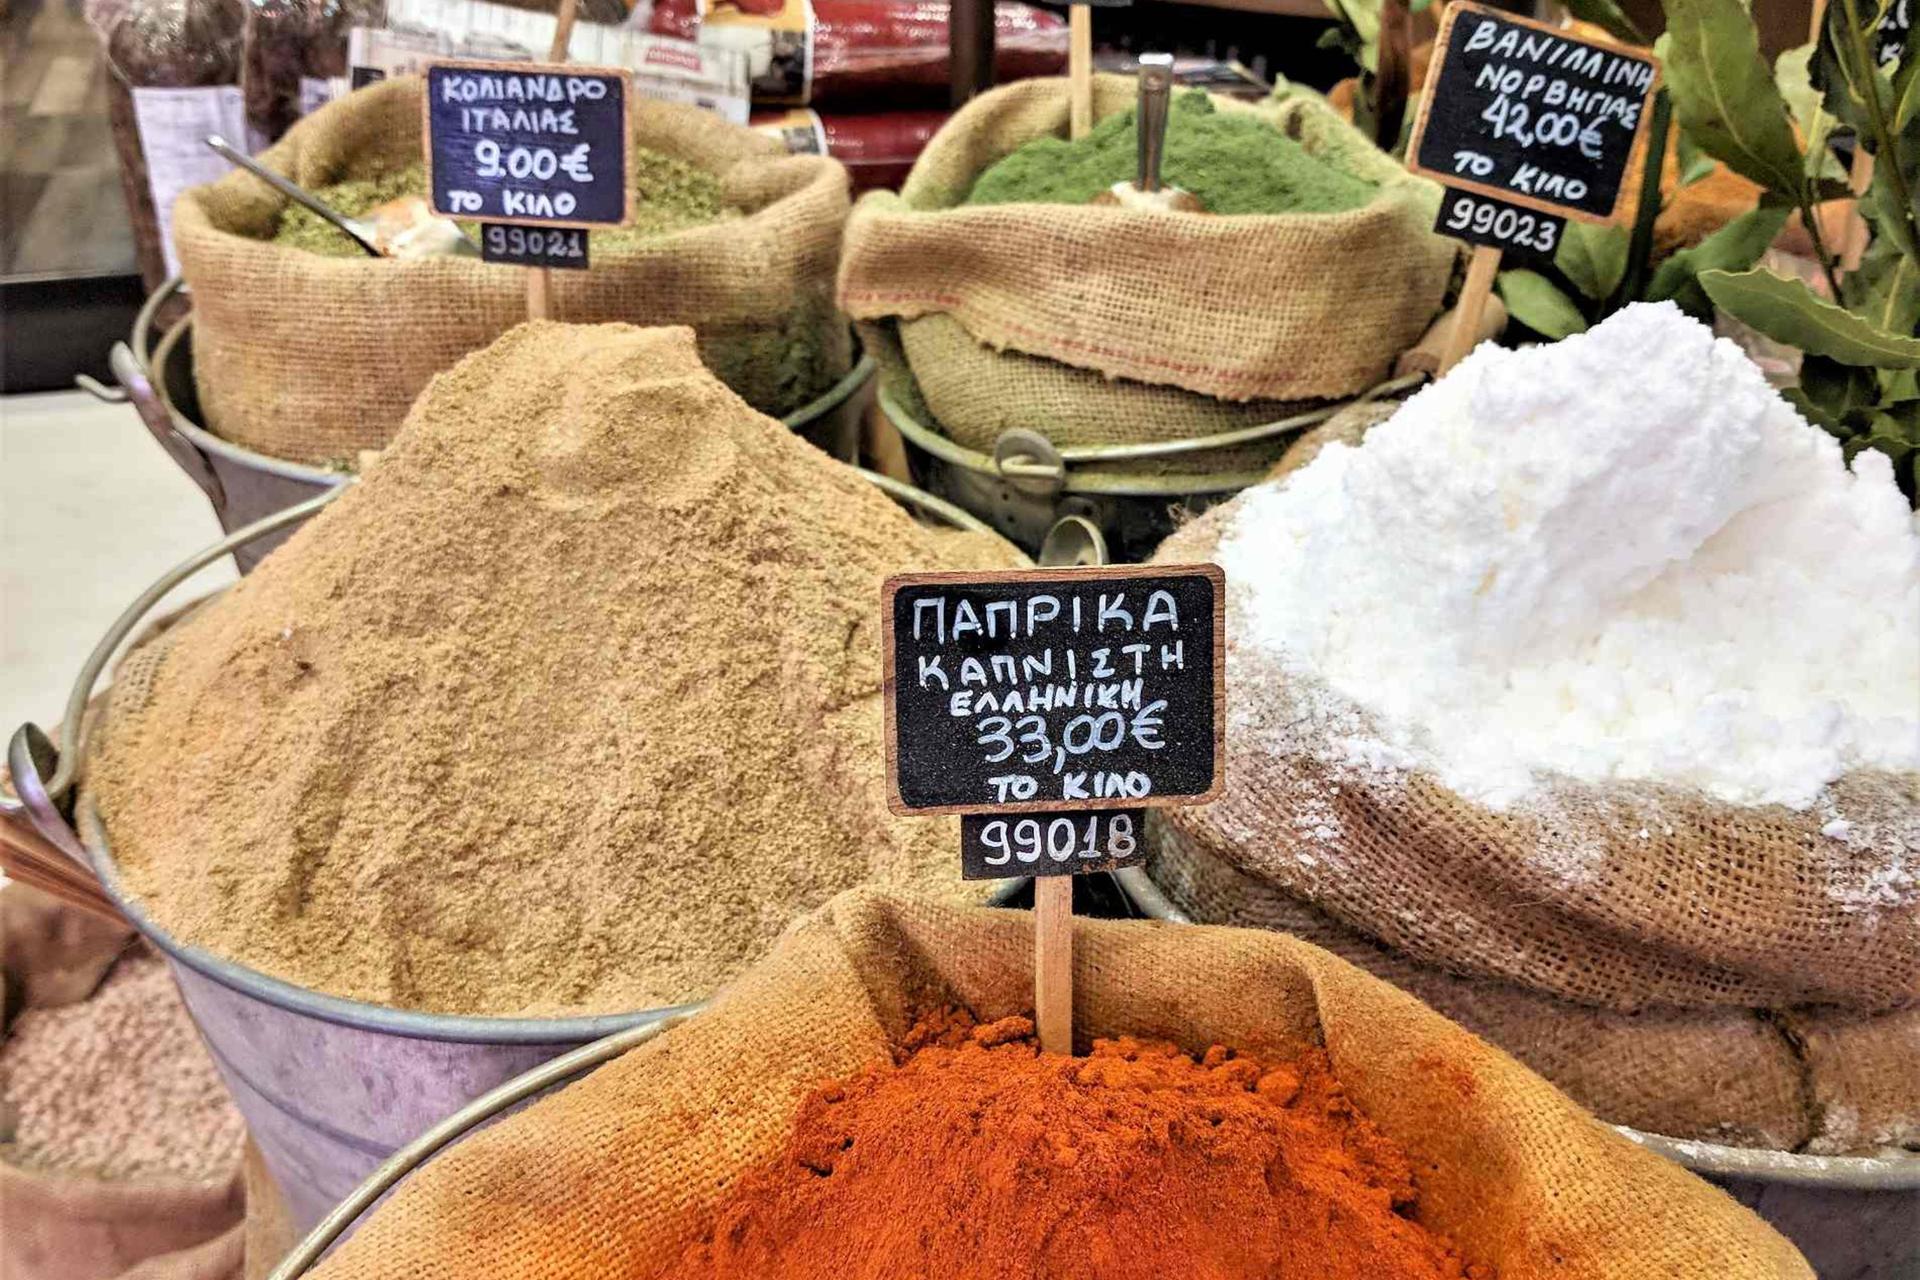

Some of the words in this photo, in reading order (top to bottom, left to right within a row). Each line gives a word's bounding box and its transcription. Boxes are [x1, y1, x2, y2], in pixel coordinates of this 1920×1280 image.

[442, 75, 606, 102] ΚΟΛΙΑΝΔΡΟ
[1475, 63, 1642, 130] ΝΟΡΒΗΓΙΑΣ
[461, 108, 579, 134] ΙΤΑΛΙΑΣ
[1481, 94, 1608, 160] 42,00€
[502, 189, 577, 217] ΚΙΛΟ
[1446, 198, 1557, 252] 99023
[487, 226, 584, 257] 99021
[913, 590, 1179, 644] ΠΑΠΡΙΚΑ
[918, 640, 1184, 690] ΚΑΠΝΙΣΤΗ
[950, 678, 1144, 717] ΕΛΛΗΝΙΚΗ
[977, 700, 1168, 774] 33,00€
[1063, 771, 1151, 799] ΚΙΛΟ
[980, 813, 1136, 865] 99018
